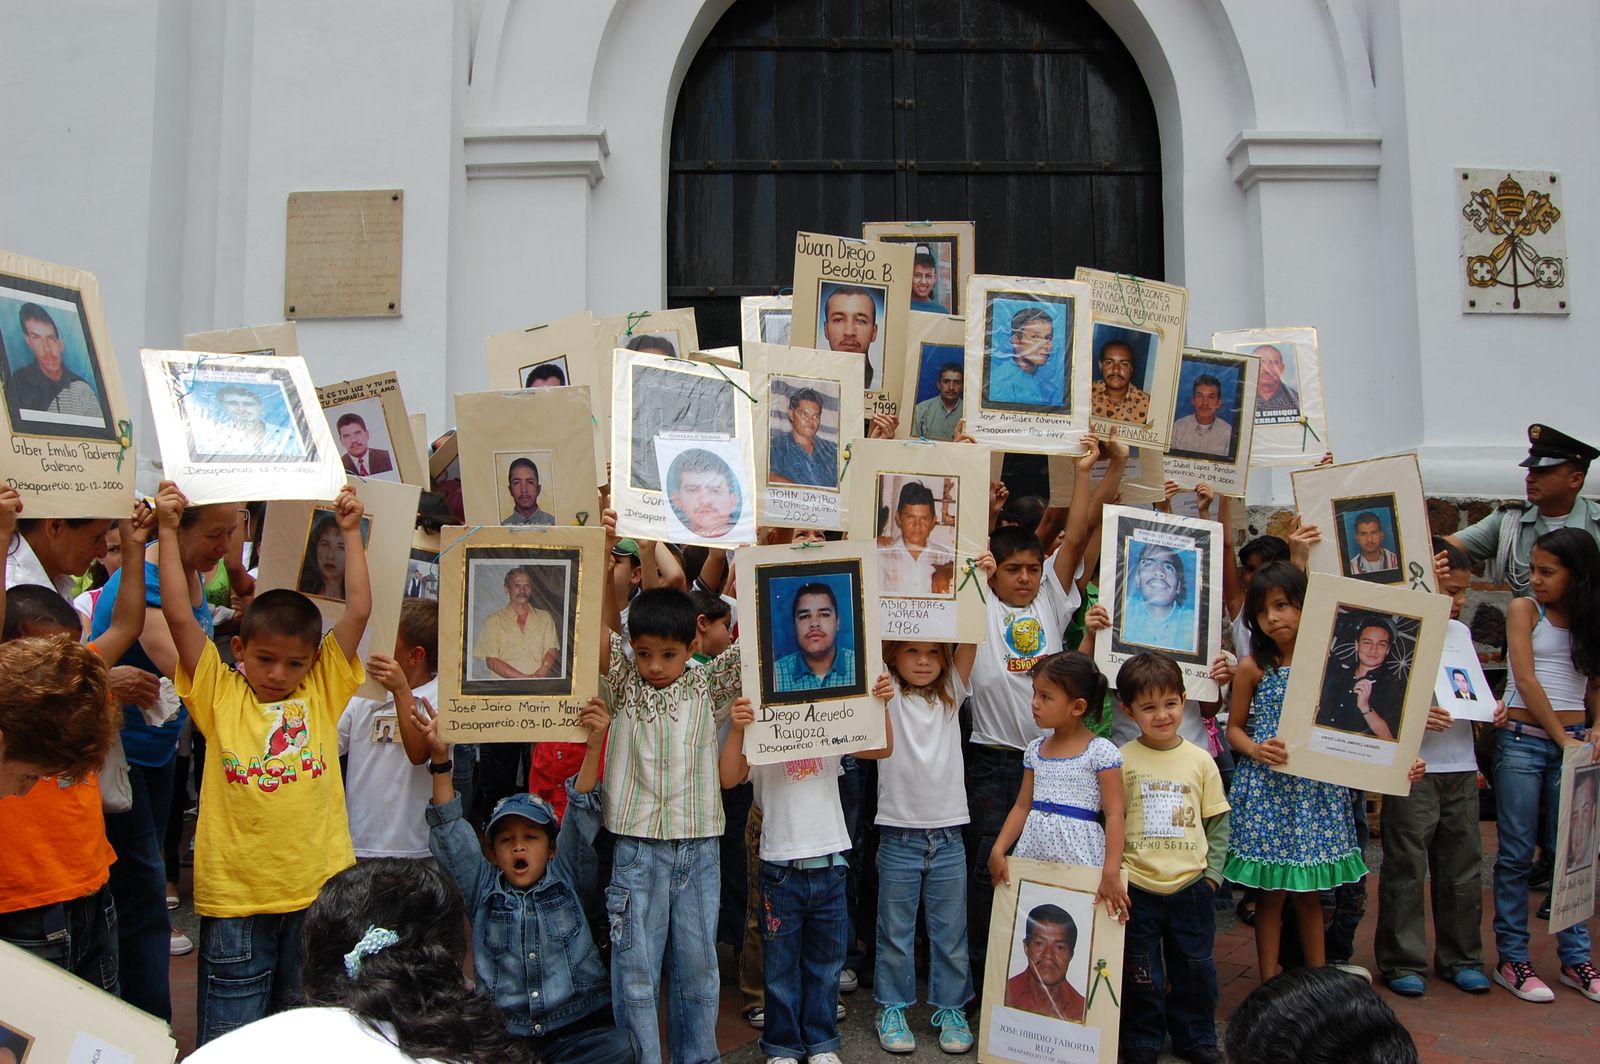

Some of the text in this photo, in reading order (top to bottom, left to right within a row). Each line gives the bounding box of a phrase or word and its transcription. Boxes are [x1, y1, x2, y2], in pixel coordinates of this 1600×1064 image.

[797, 234, 876, 268] Juan Diego
[822, 259, 876, 282] Bedoya
[1092, 289, 1102, 299] EN
[1263, 409, 1298, 417] ENRIQUE
[47, 441, 78, 458] Emilio
[768, 488, 798, 500] JOHN
[784, 510, 819, 523] 2000
[885, 620, 920, 635] 1986
[481, 698, 512, 712] Jairo
[757, 706, 800, 725] Diego
[221, 751, 297, 793] DRAGON
[1000, 1024, 1019, 1036] JOSE
[1054, 1037, 1096, 1054] TABORDA
[1035, 1044, 1055, 1056] RUIZ
